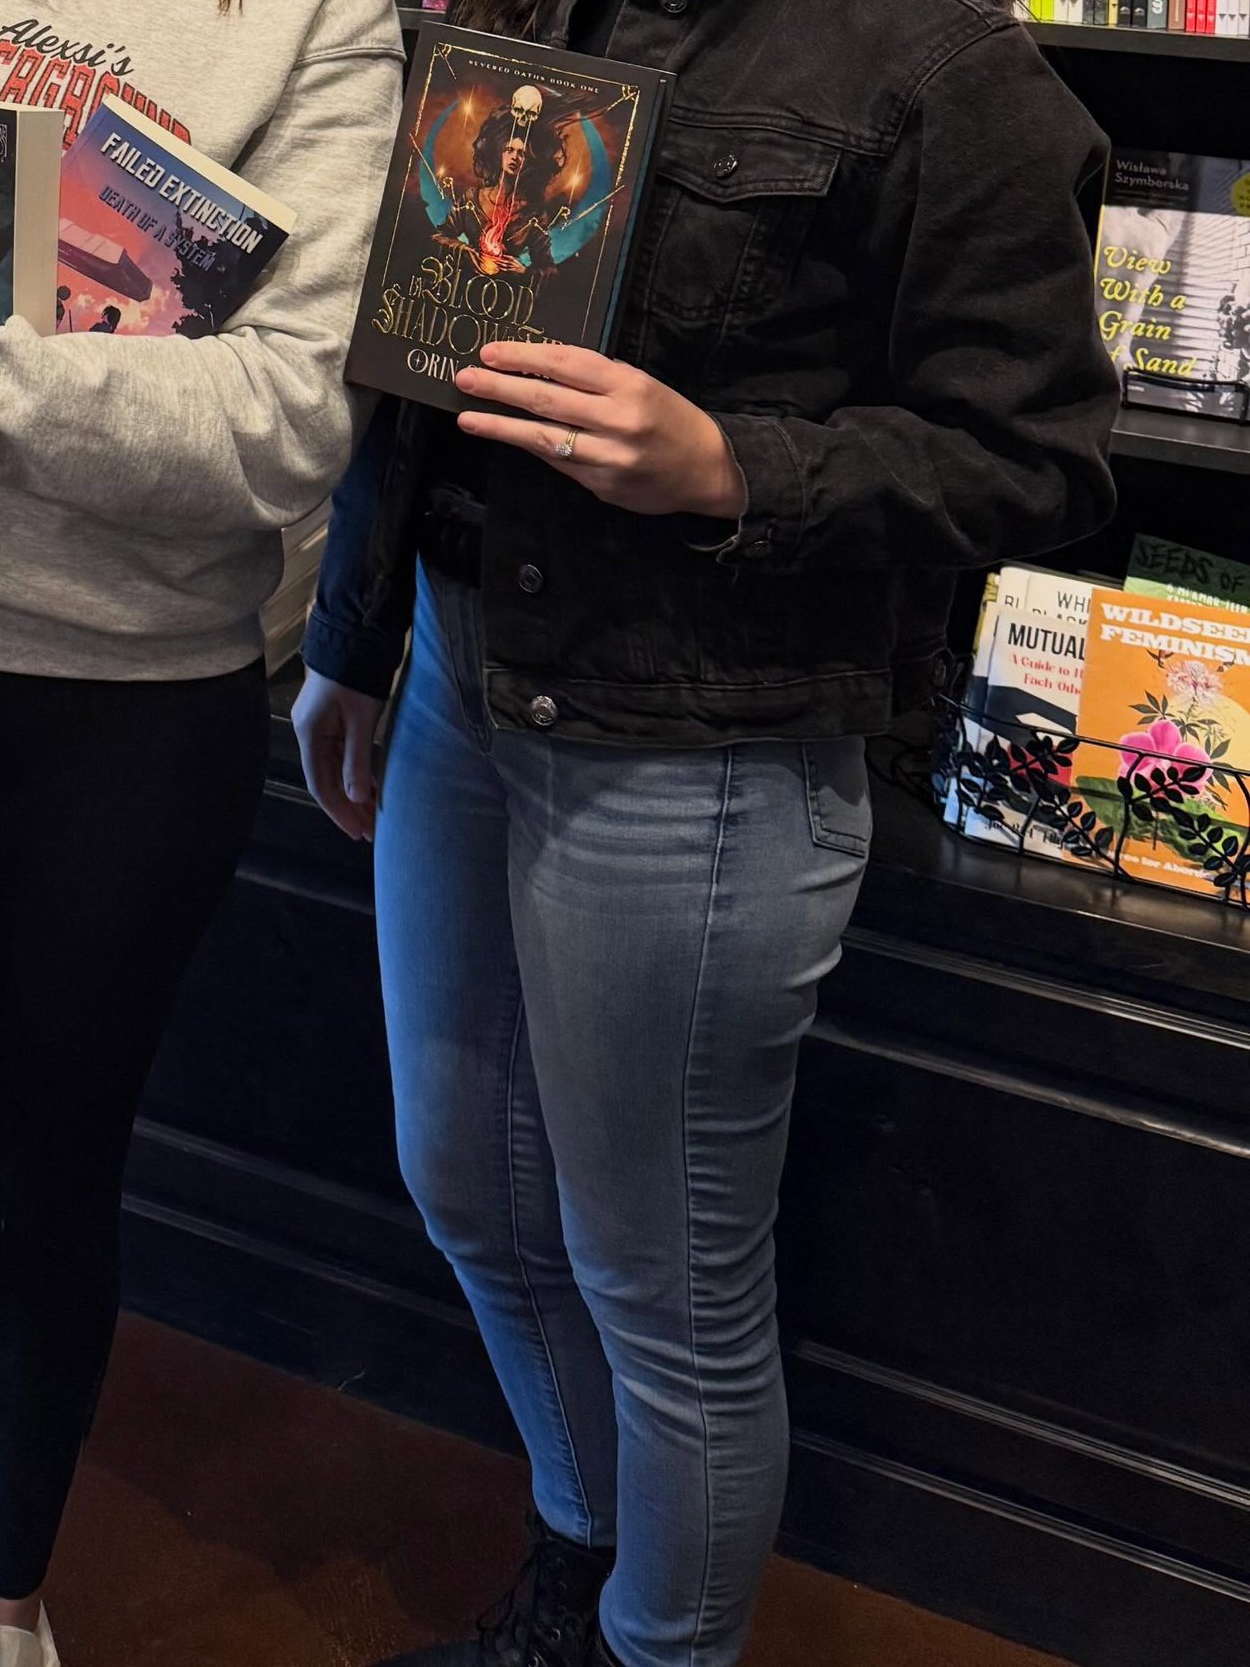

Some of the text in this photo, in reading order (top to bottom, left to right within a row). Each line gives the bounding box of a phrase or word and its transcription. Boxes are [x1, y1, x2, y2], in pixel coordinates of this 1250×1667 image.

[468, 59, 510, 74] SEVERED
[100, 132, 264, 254] FAILED EXTINCTION
[1114, 172, 1190, 192] Szymborska
[99, 186, 218, 272] DEATH OF SYSTEM
[1103, 246, 1172, 275] View
[421, 253, 535, 326] BLOOD
[1100, 278, 1188, 310] With a
[371, 283, 511, 355] SHADOW
[1099, 311, 1172, 342] Grain
[406, 348, 460, 384] ORIN
[1124, 348, 1196, 377] Sand
[1138, 540, 1215, 584] SEEDS
[1008, 622, 1086, 661] MUTUAL
[1021, 655, 1070, 676] Guide to
[1023, 672, 1052, 689] Each
